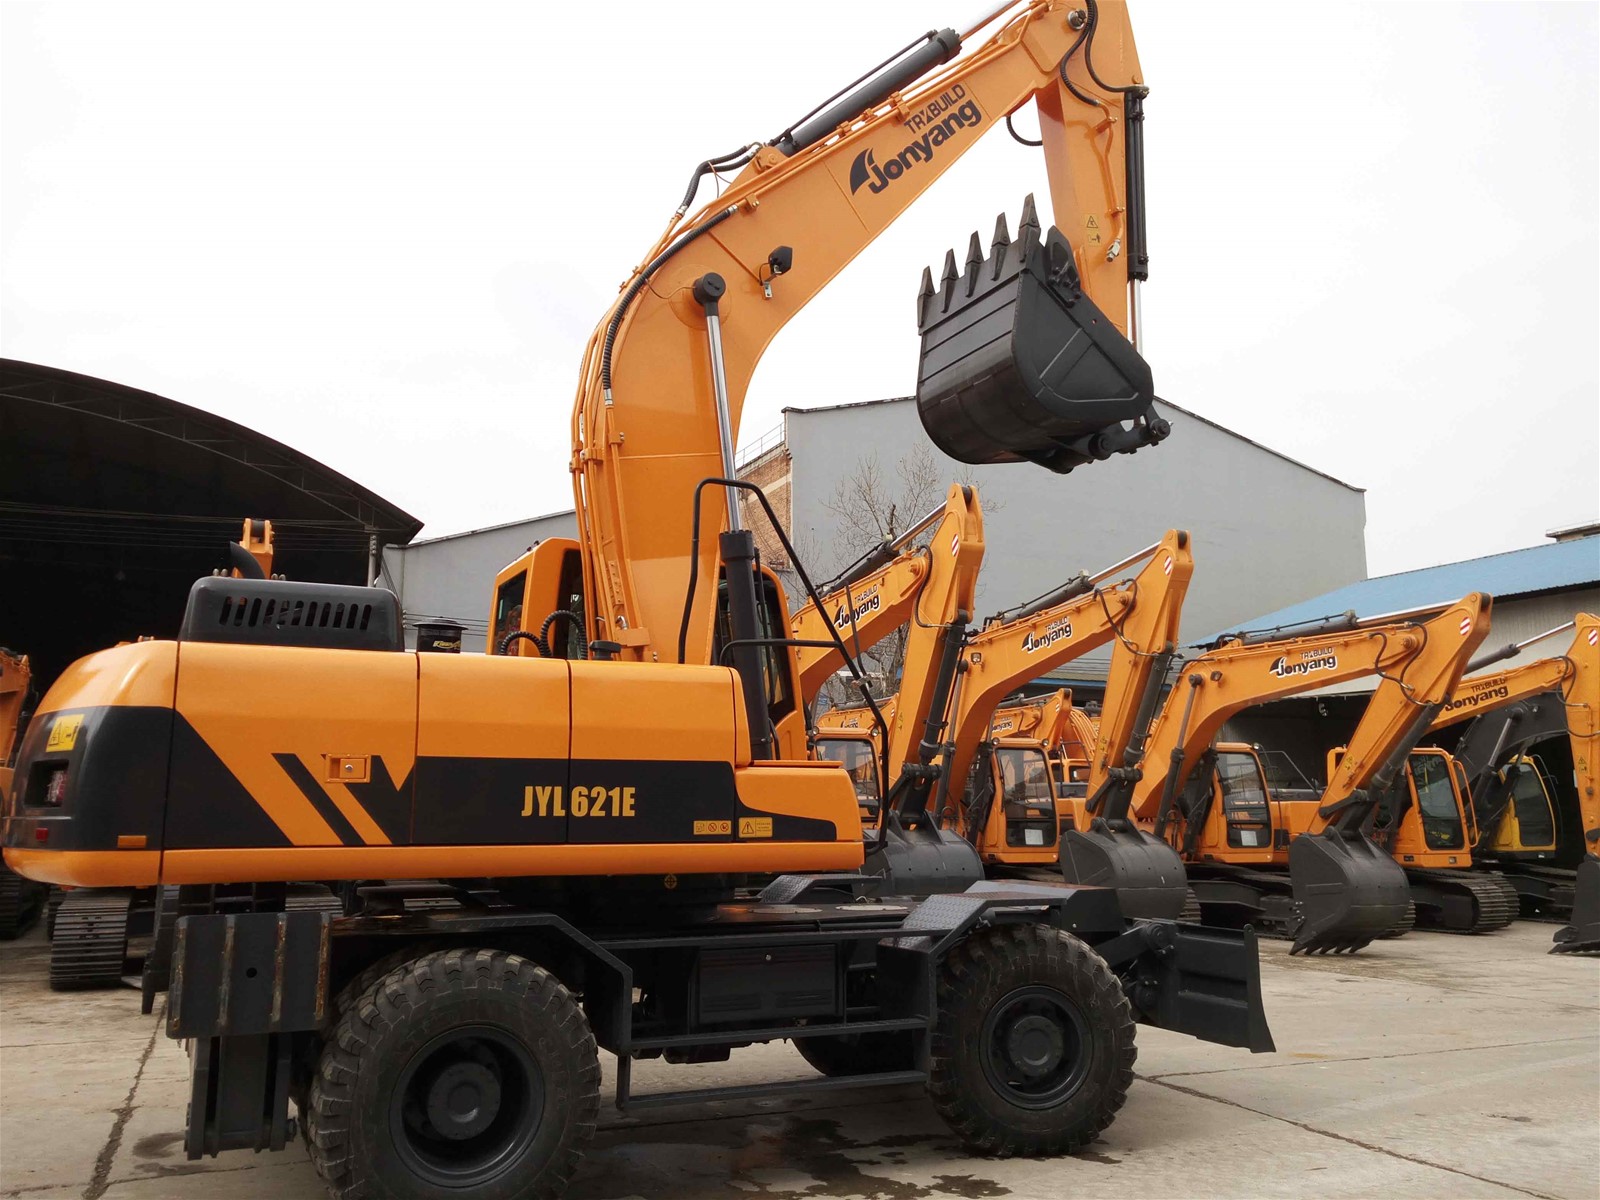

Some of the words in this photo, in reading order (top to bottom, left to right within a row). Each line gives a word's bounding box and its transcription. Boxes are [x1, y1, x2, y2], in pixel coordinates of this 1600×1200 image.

[868, 99, 982, 194] Jonyang
[838, 595, 880, 629] Joyang
[1027, 623, 1072, 652] Jonyang
[1277, 656, 1336, 677] Jonyang
[521, 786, 566, 816] JYL
[571, 786, 635, 817] 621E
